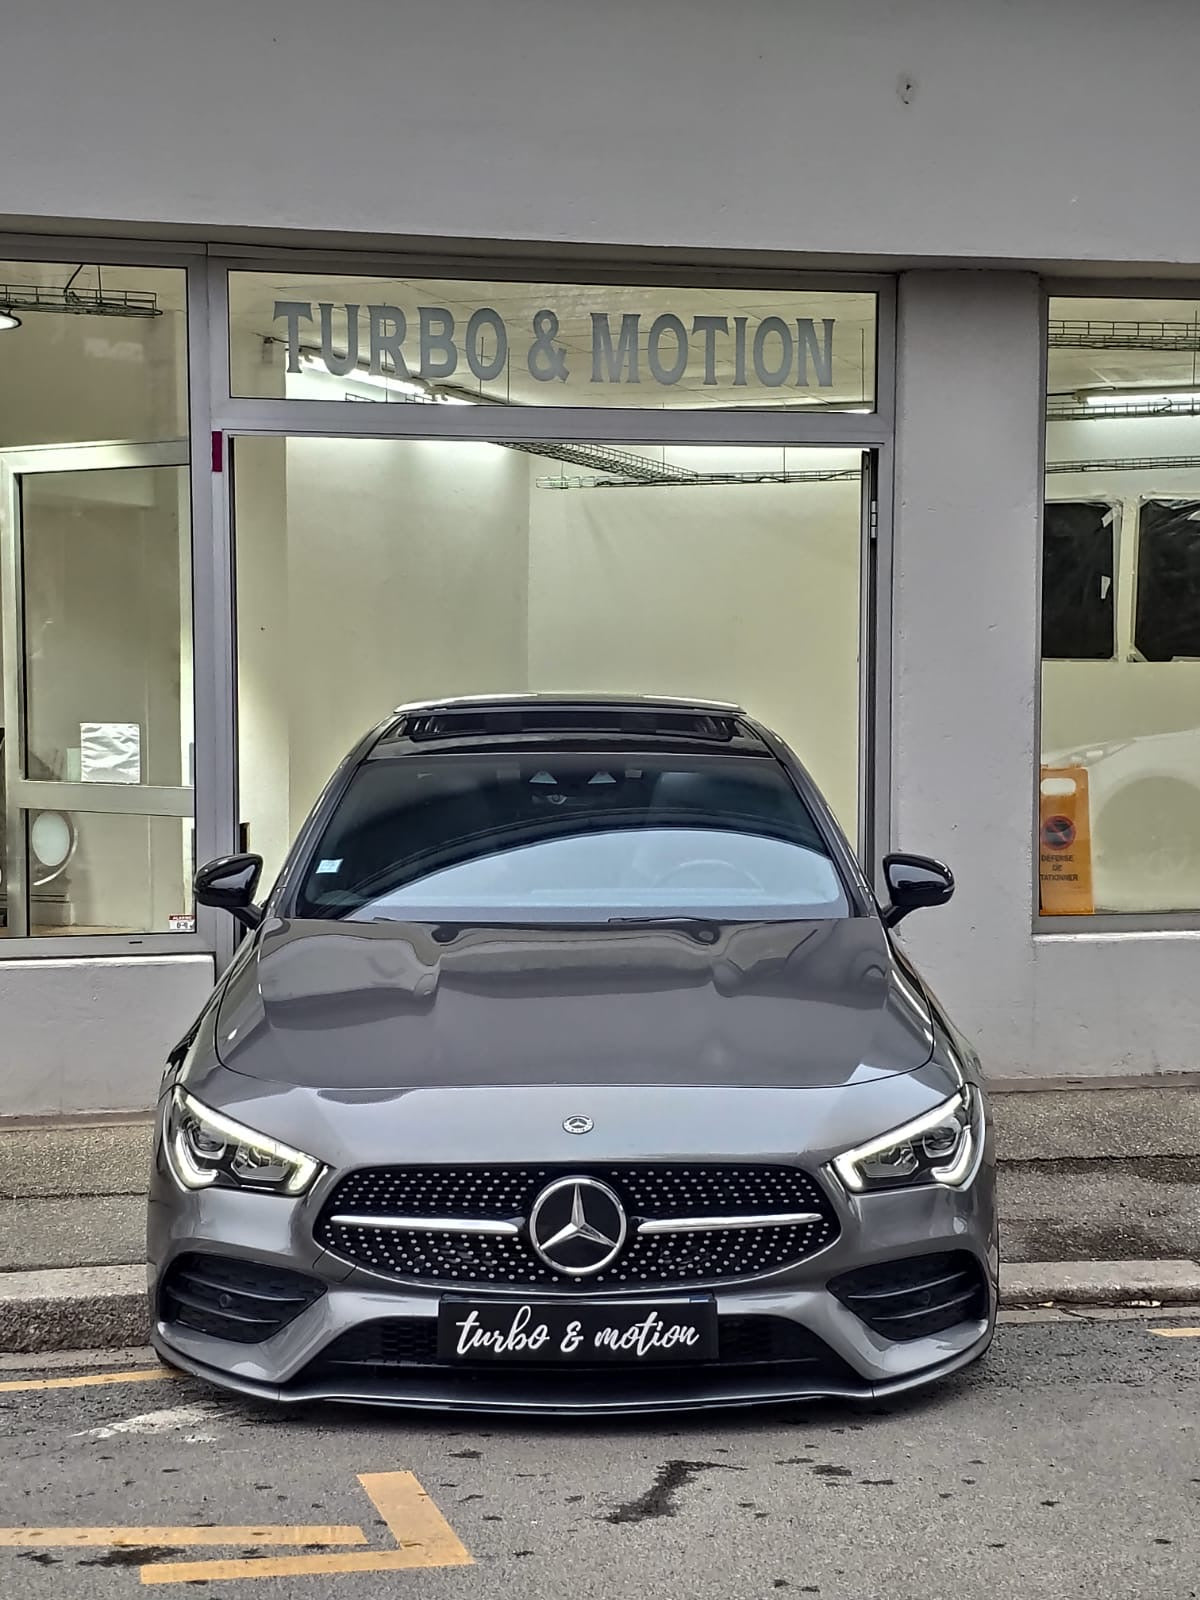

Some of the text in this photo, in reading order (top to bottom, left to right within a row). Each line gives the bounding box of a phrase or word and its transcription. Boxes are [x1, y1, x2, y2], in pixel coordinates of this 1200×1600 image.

[273, 301, 836, 387] TURBO & MOTION
[1040, 873, 1078, 881] TATIONNER
[456, 1305, 699, 1356] turbo & motion
